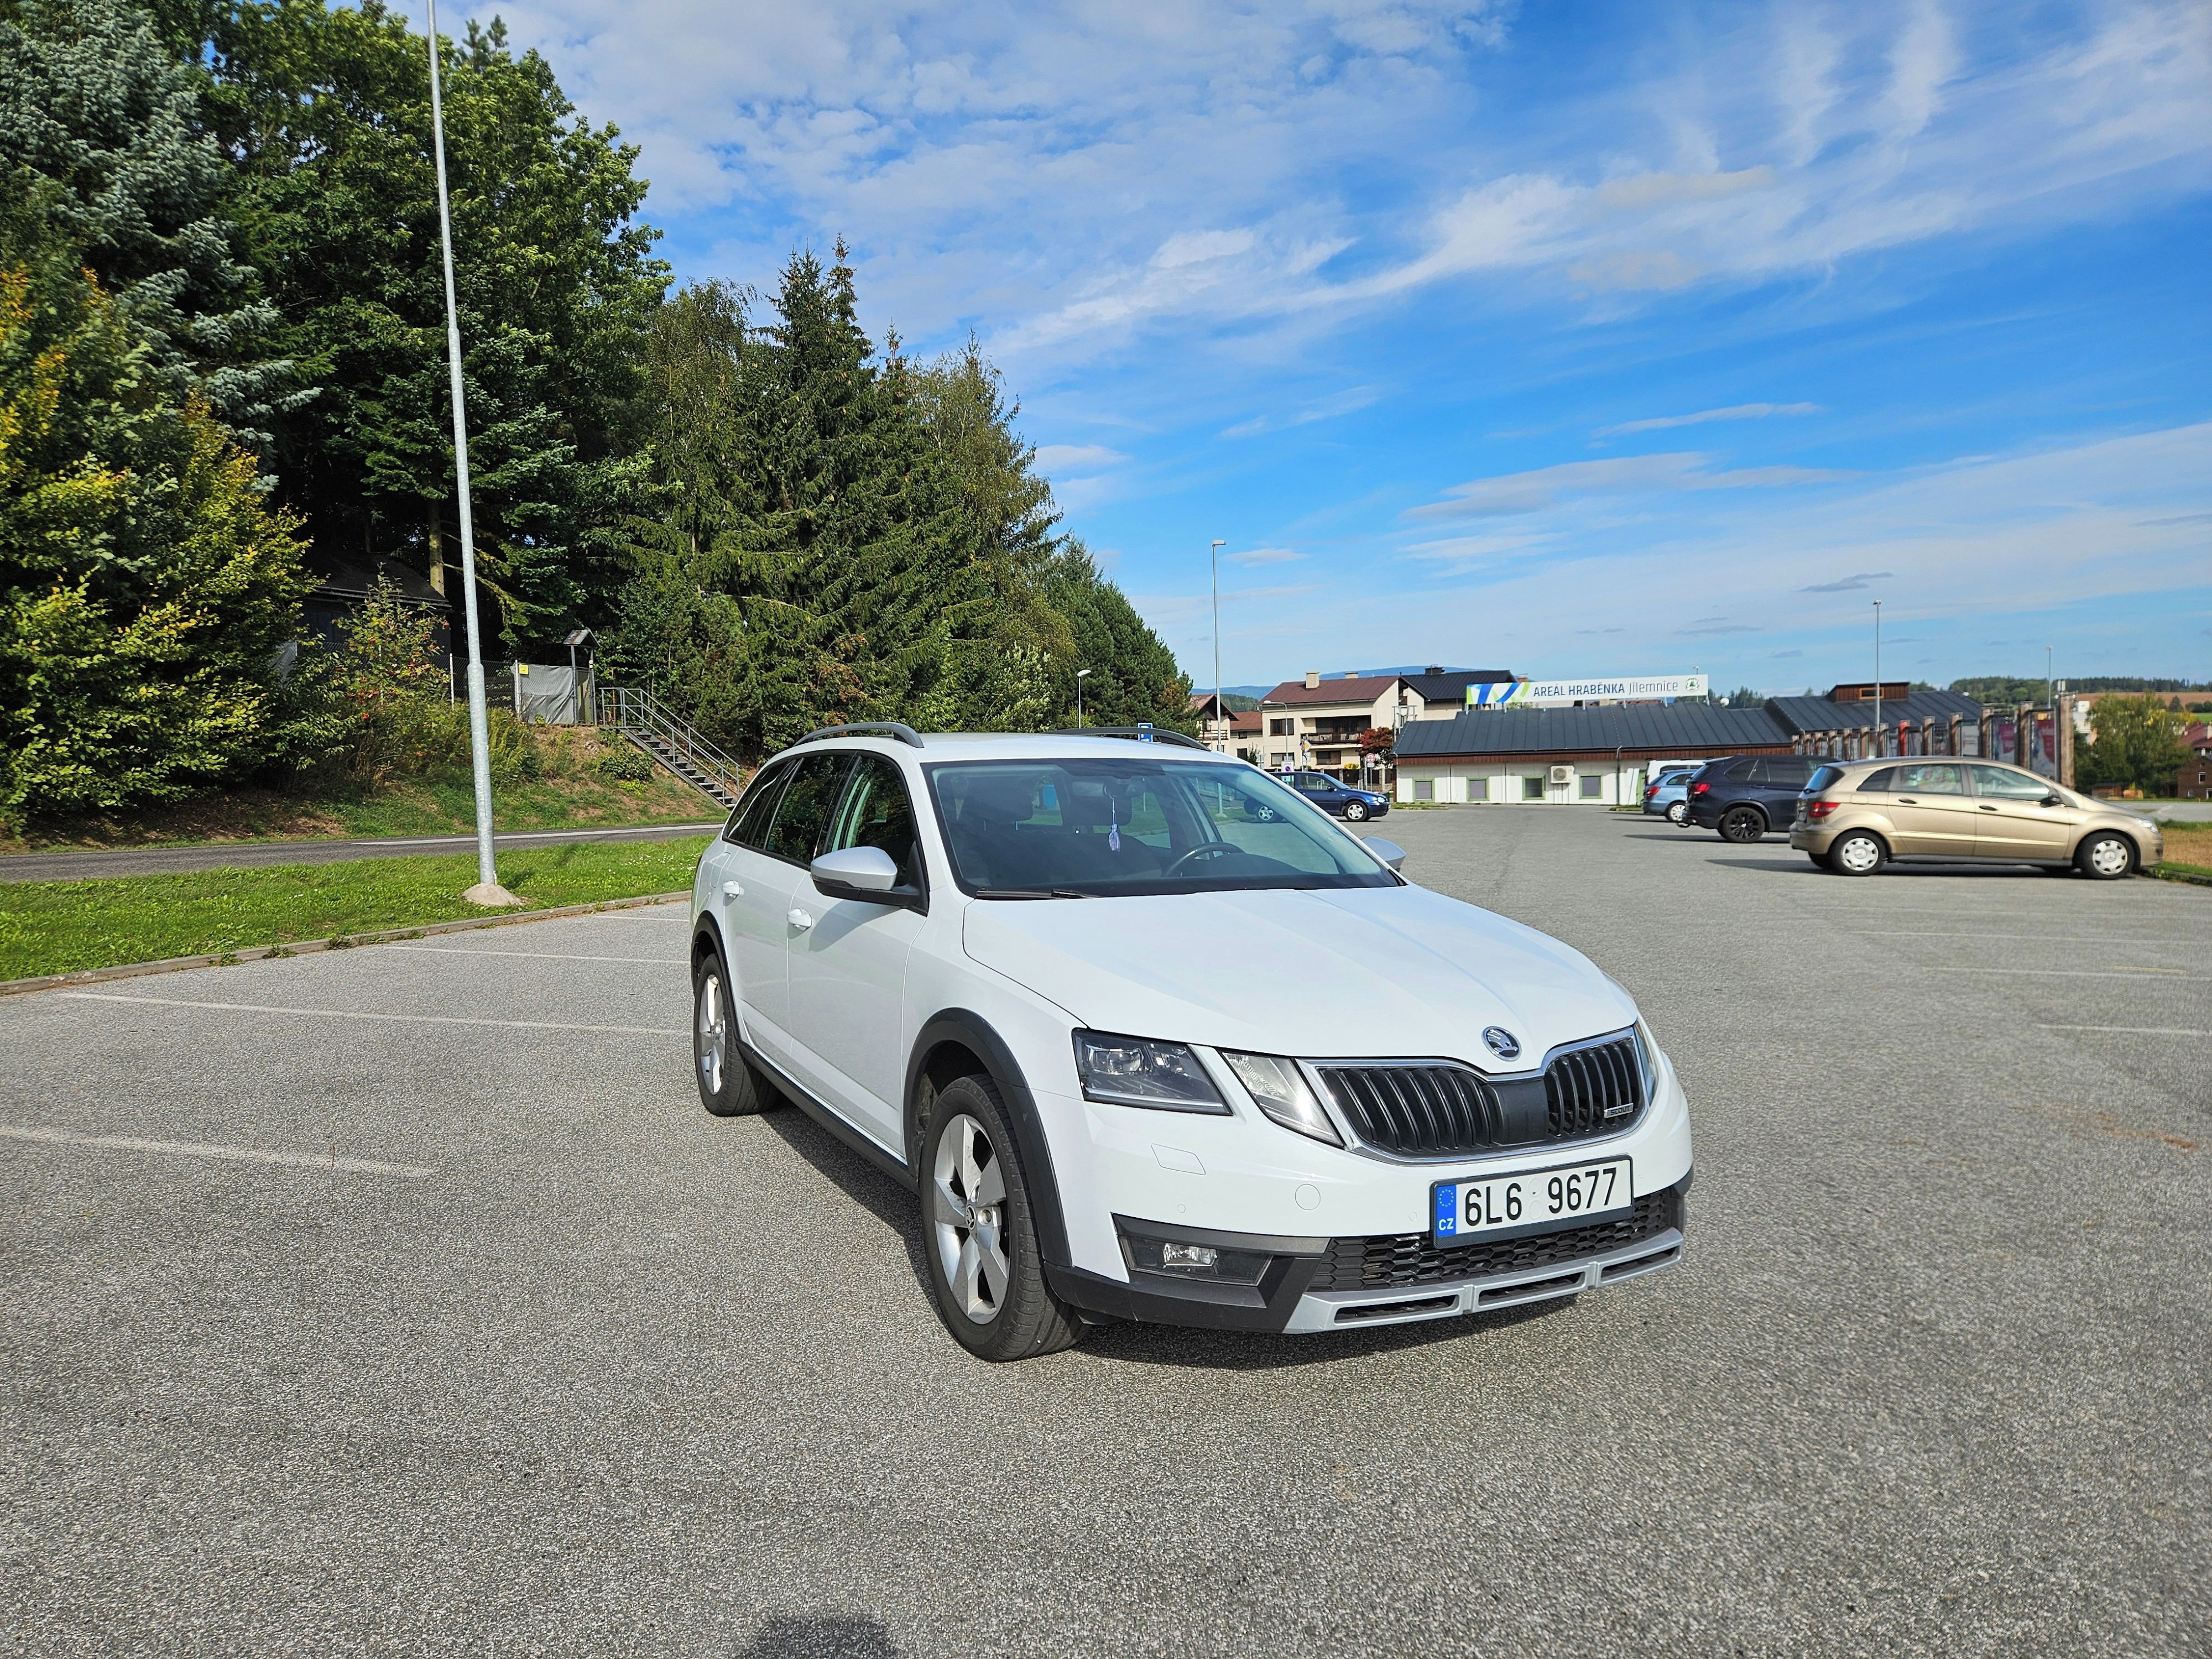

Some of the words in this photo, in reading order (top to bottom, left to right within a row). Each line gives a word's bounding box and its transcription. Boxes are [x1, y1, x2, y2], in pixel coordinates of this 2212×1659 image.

[1533, 684, 1566, 697] AREÁL
[1629, 680, 1678, 695] Jilemnice
[1610, 1106, 1630, 1115] SCOUT
[1465, 1183, 1522, 1226] 6L6
[1548, 1167, 1616, 1214] 9677
[1439, 1218, 1454, 1230] CZ
